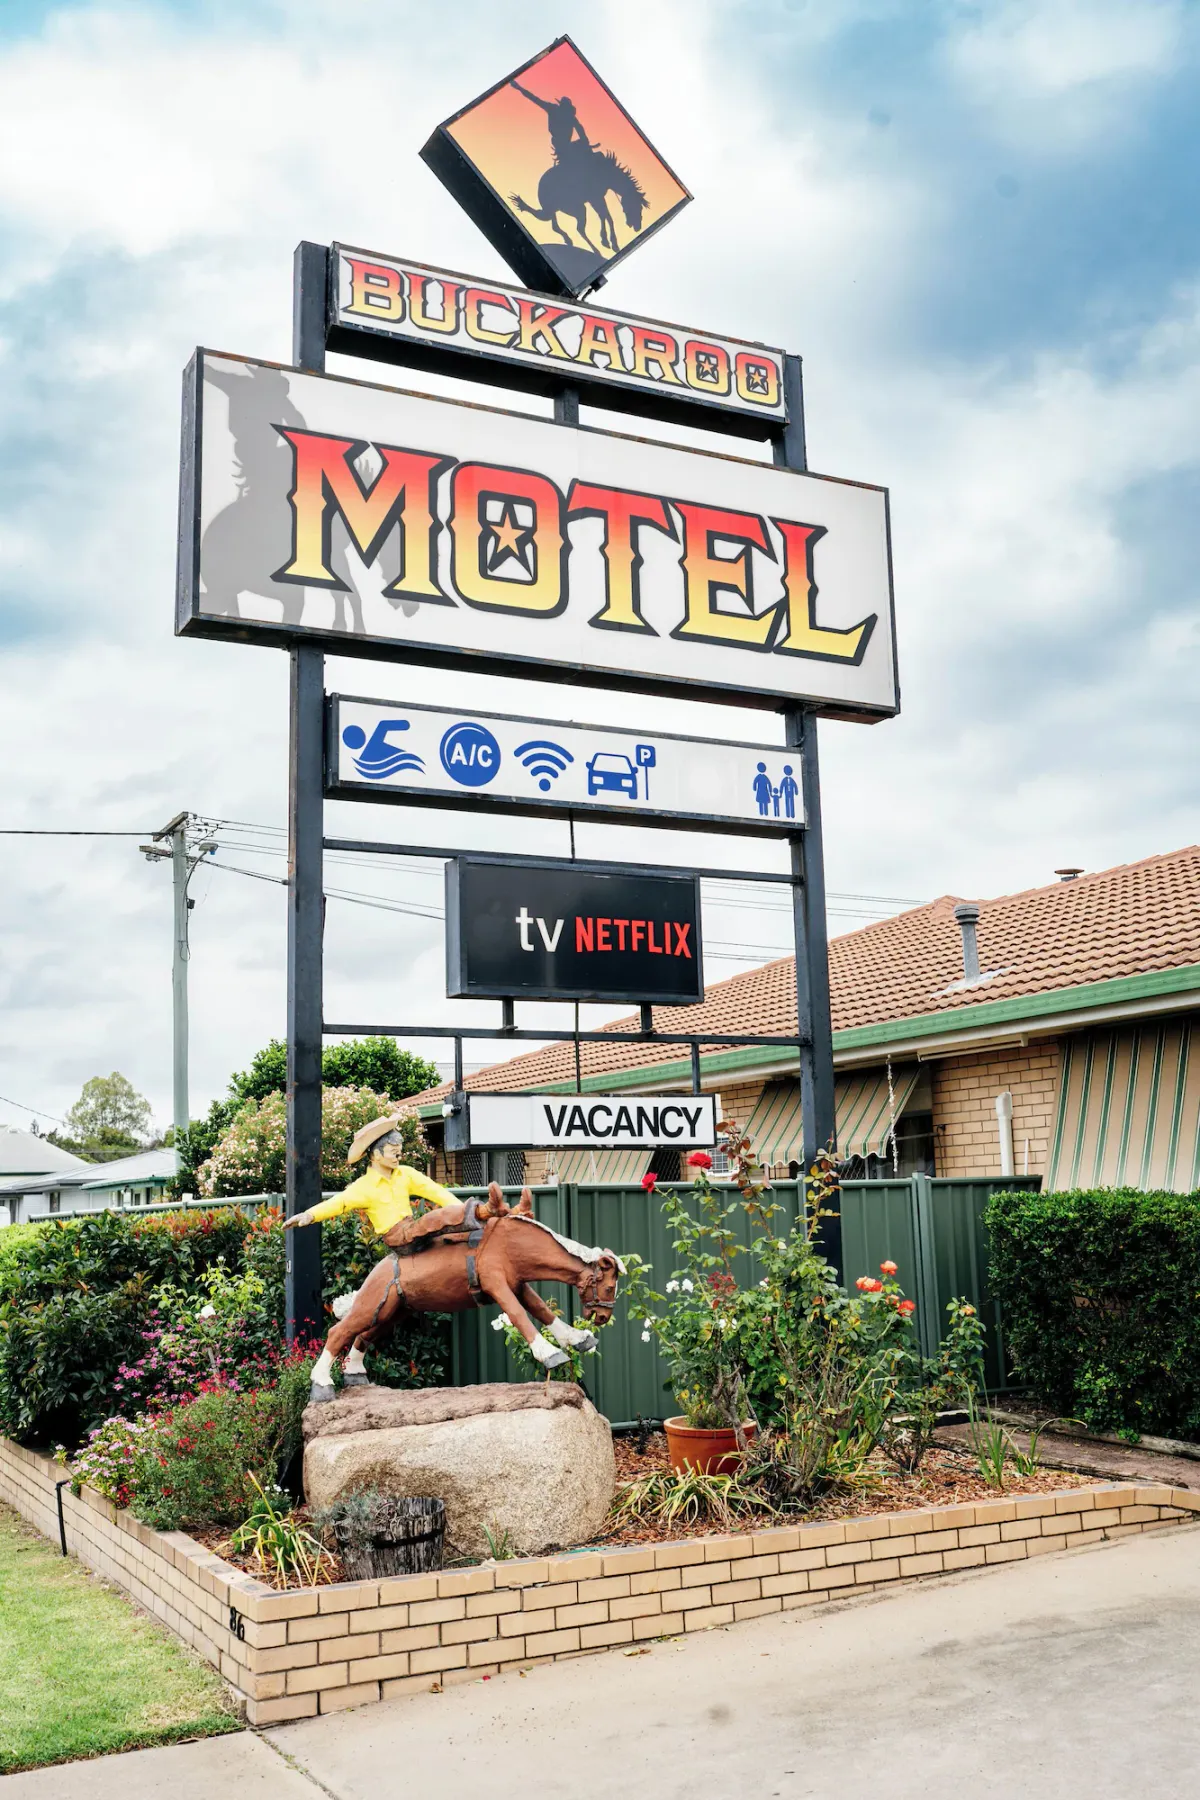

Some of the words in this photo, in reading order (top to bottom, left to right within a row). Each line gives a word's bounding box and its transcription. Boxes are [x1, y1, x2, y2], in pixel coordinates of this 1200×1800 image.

[342, 256, 783, 408] BUCKAROO
[270, 423, 879, 666] MOTEL
[450, 742, 493, 768] A/C
[640, 748, 653, 763] P
[515, 906, 564, 953] tv
[575, 916, 692, 959] NETFLIX
[543, 1104, 703, 1138] VACANCY
[230, 1606, 245, 1641] 86
